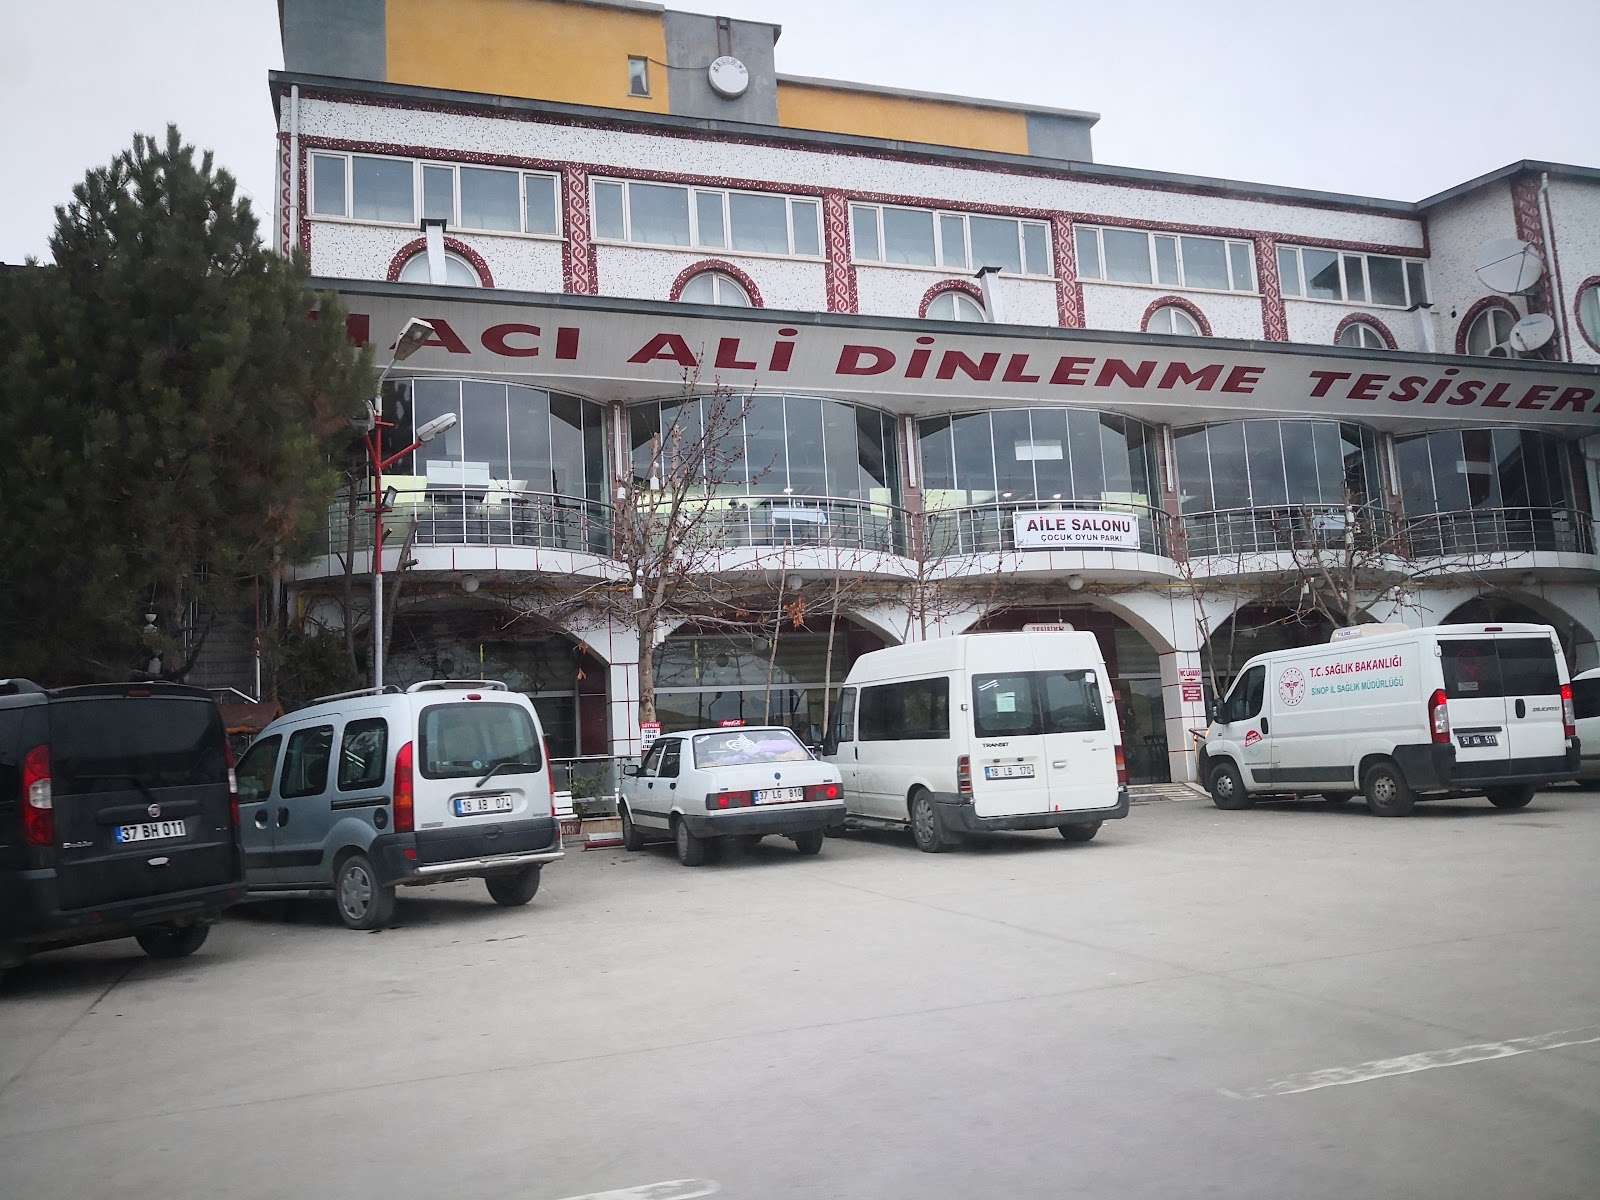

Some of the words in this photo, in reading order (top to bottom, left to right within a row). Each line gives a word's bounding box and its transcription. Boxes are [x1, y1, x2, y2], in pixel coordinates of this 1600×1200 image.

[626, 327, 798, 372] ALİ
[834, 336, 1266, 394] DİNLENME
[1309, 368, 1600, 414] TESİSLER
[1027, 517, 1066, 532] AİLE
[1071, 518, 1131, 533] SALONU
[1040, 534, 1073, 543] ÇOCUK
[1100, 534, 1122, 542] PARKI
[1309, 667, 1324, 678] T.C.
[1325, 662, 1354, 676] SAĞLIK
[1355, 654, 1402, 673] BAKANLIĞI
[1311, 686, 1329, 696] SİNOP
[1330, 684, 1336, 694] İL
[1337, 682, 1361, 693] SAĞLIK
[1361, 675, 1404, 690] MÜDÜRLÜĞÜ
[759, 791, 768, 800] 37
[789, 788, 802, 798] 810
[122, 826, 137, 841] 37
[142, 824, 160, 839] BH
[164, 821, 185, 836] 011
